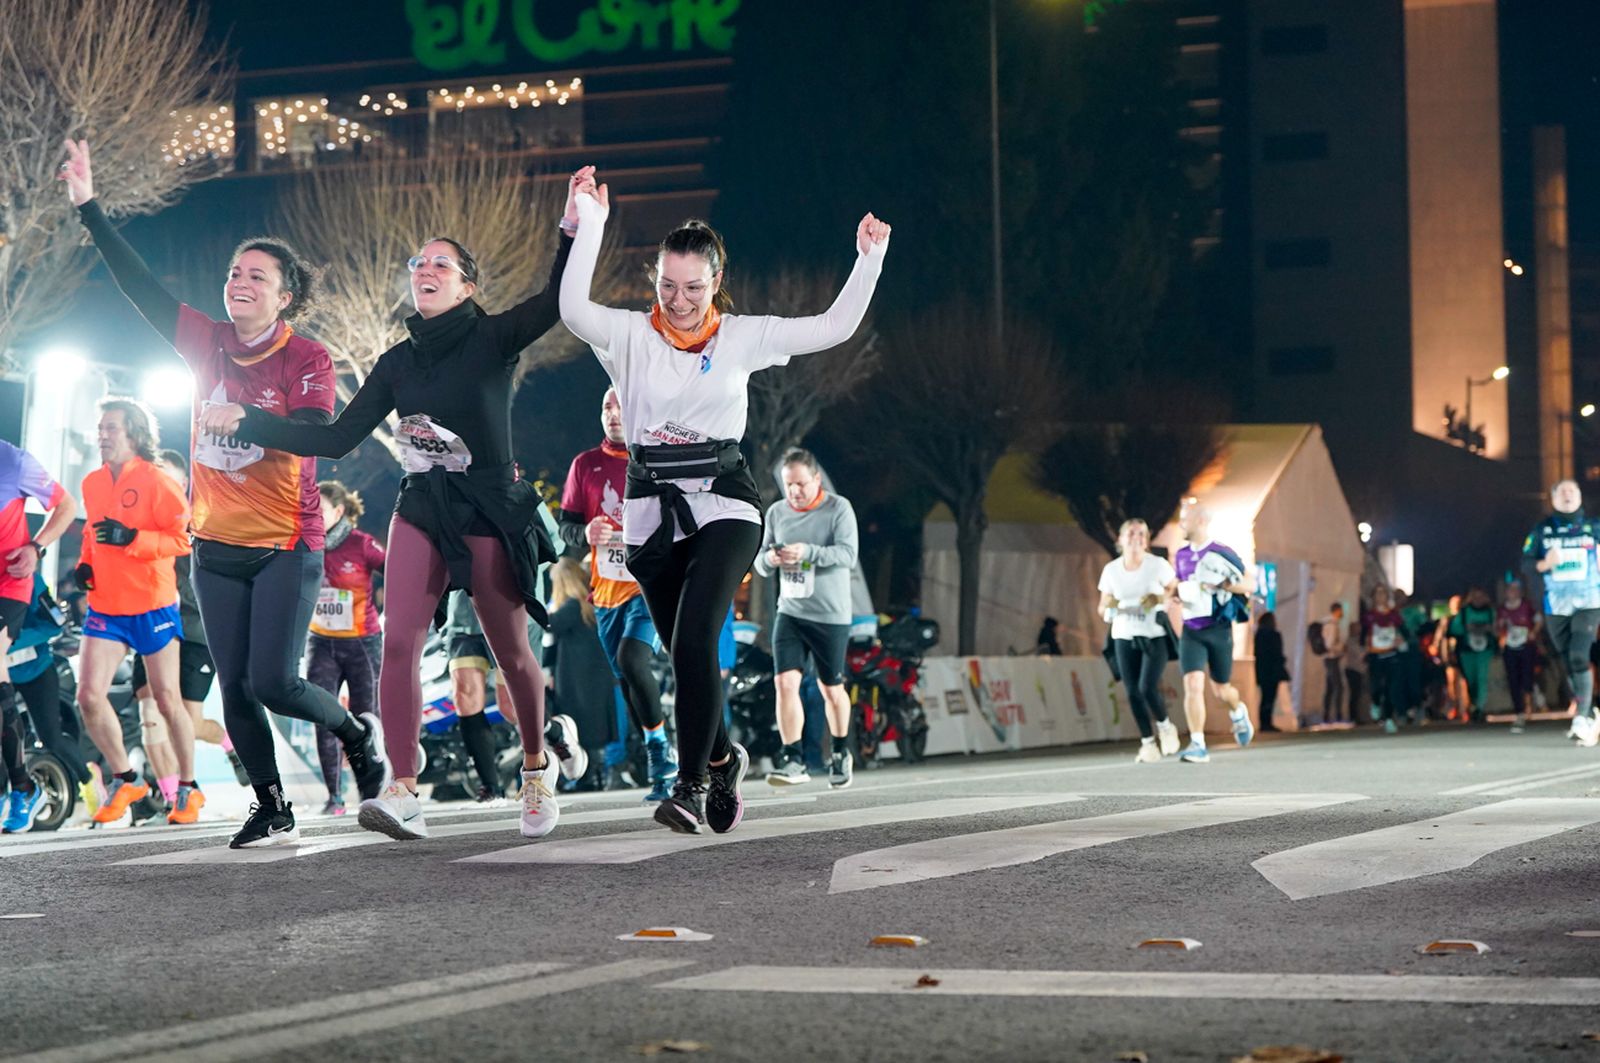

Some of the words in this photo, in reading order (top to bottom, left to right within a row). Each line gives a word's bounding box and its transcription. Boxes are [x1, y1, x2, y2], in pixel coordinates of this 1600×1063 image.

[651, 430, 669, 441] SAN
[664, 424, 689, 438] NOCHE
[689, 433, 700, 442] DE
[608, 548, 627, 563] 25
[316, 602, 343, 616] 6400
